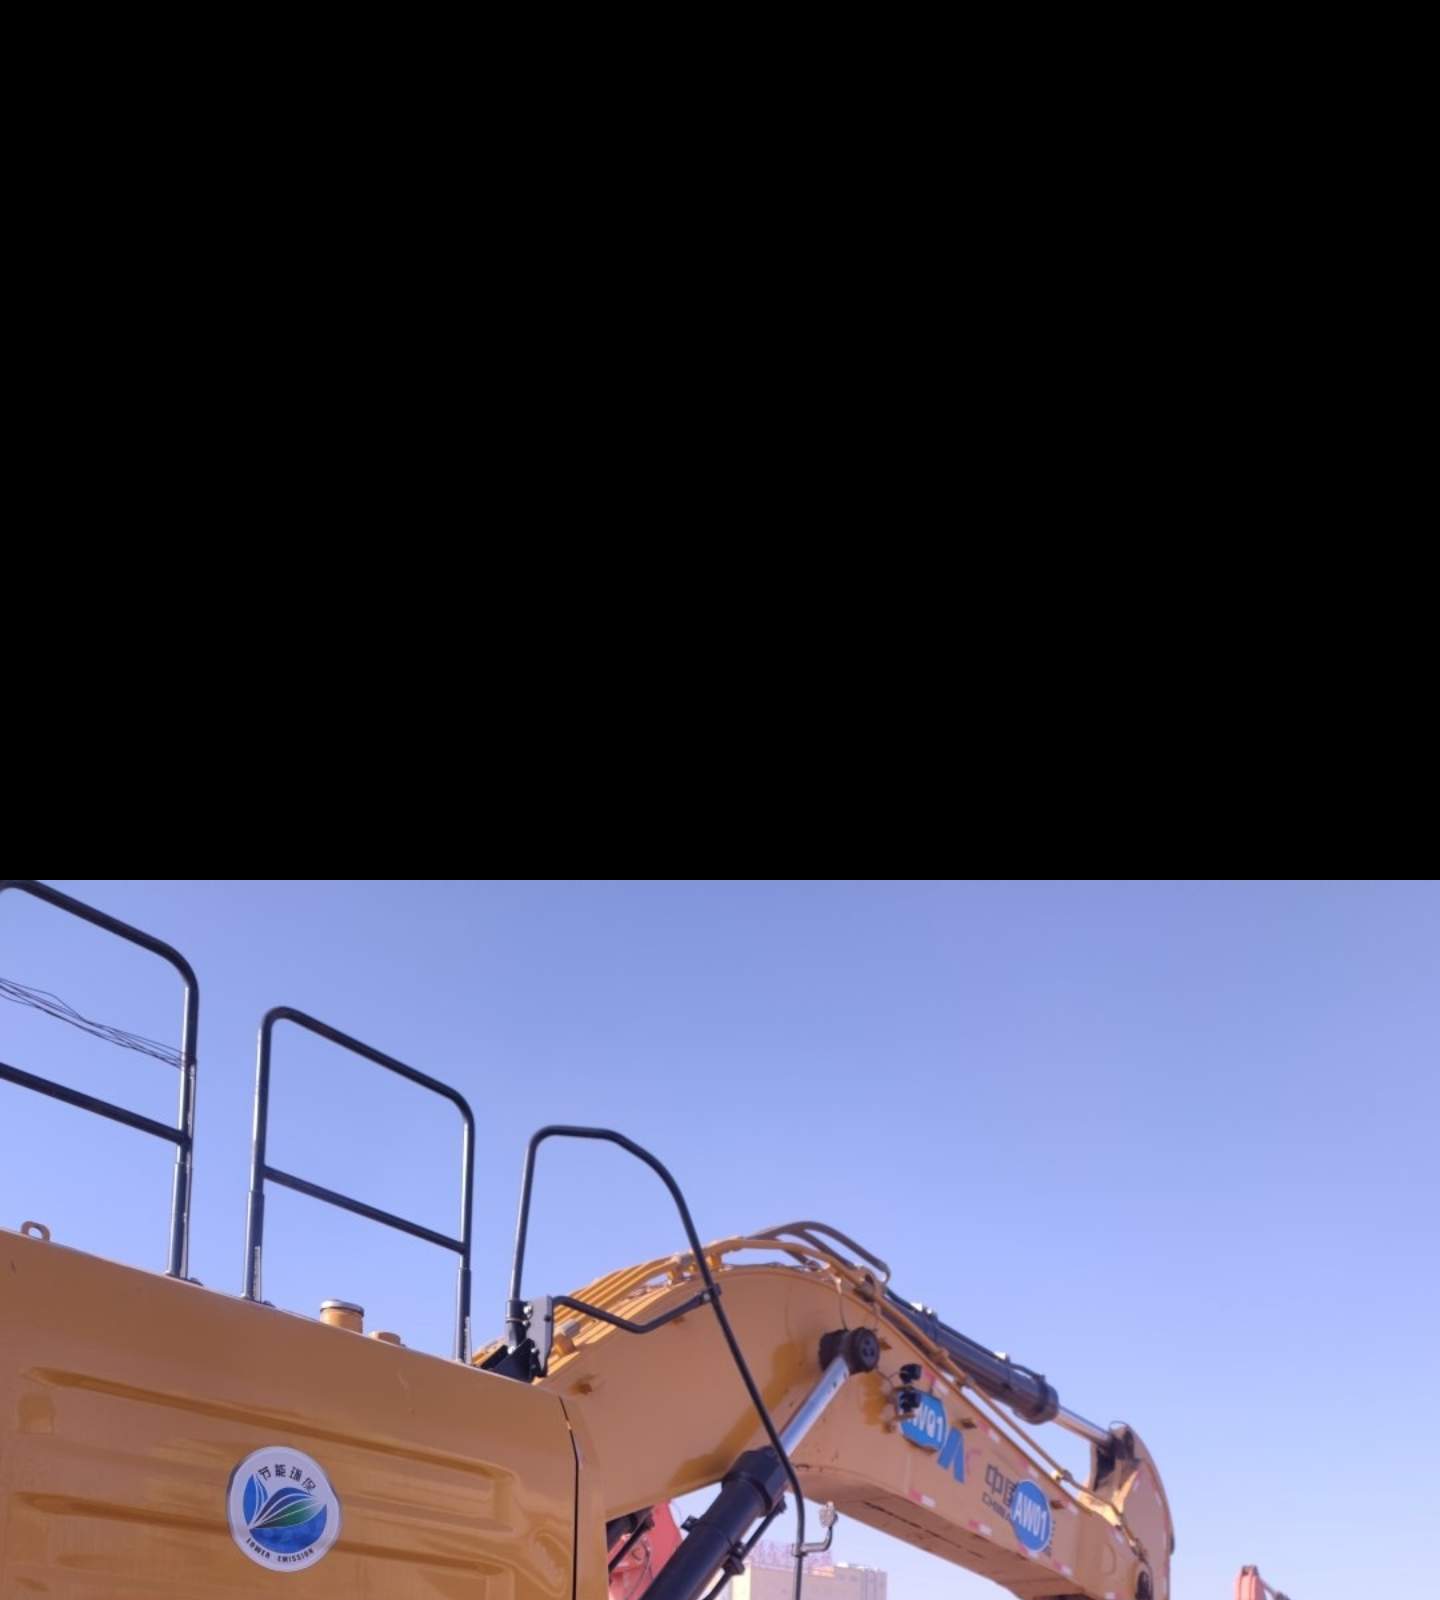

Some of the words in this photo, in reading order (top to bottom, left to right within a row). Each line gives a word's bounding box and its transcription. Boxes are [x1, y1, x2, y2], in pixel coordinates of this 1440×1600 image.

[257, 1463, 317, 1492] 节能环保
[1012, 1491, 1048, 1542] AW01
[277, 1547, 315, 1563] EMISSION
